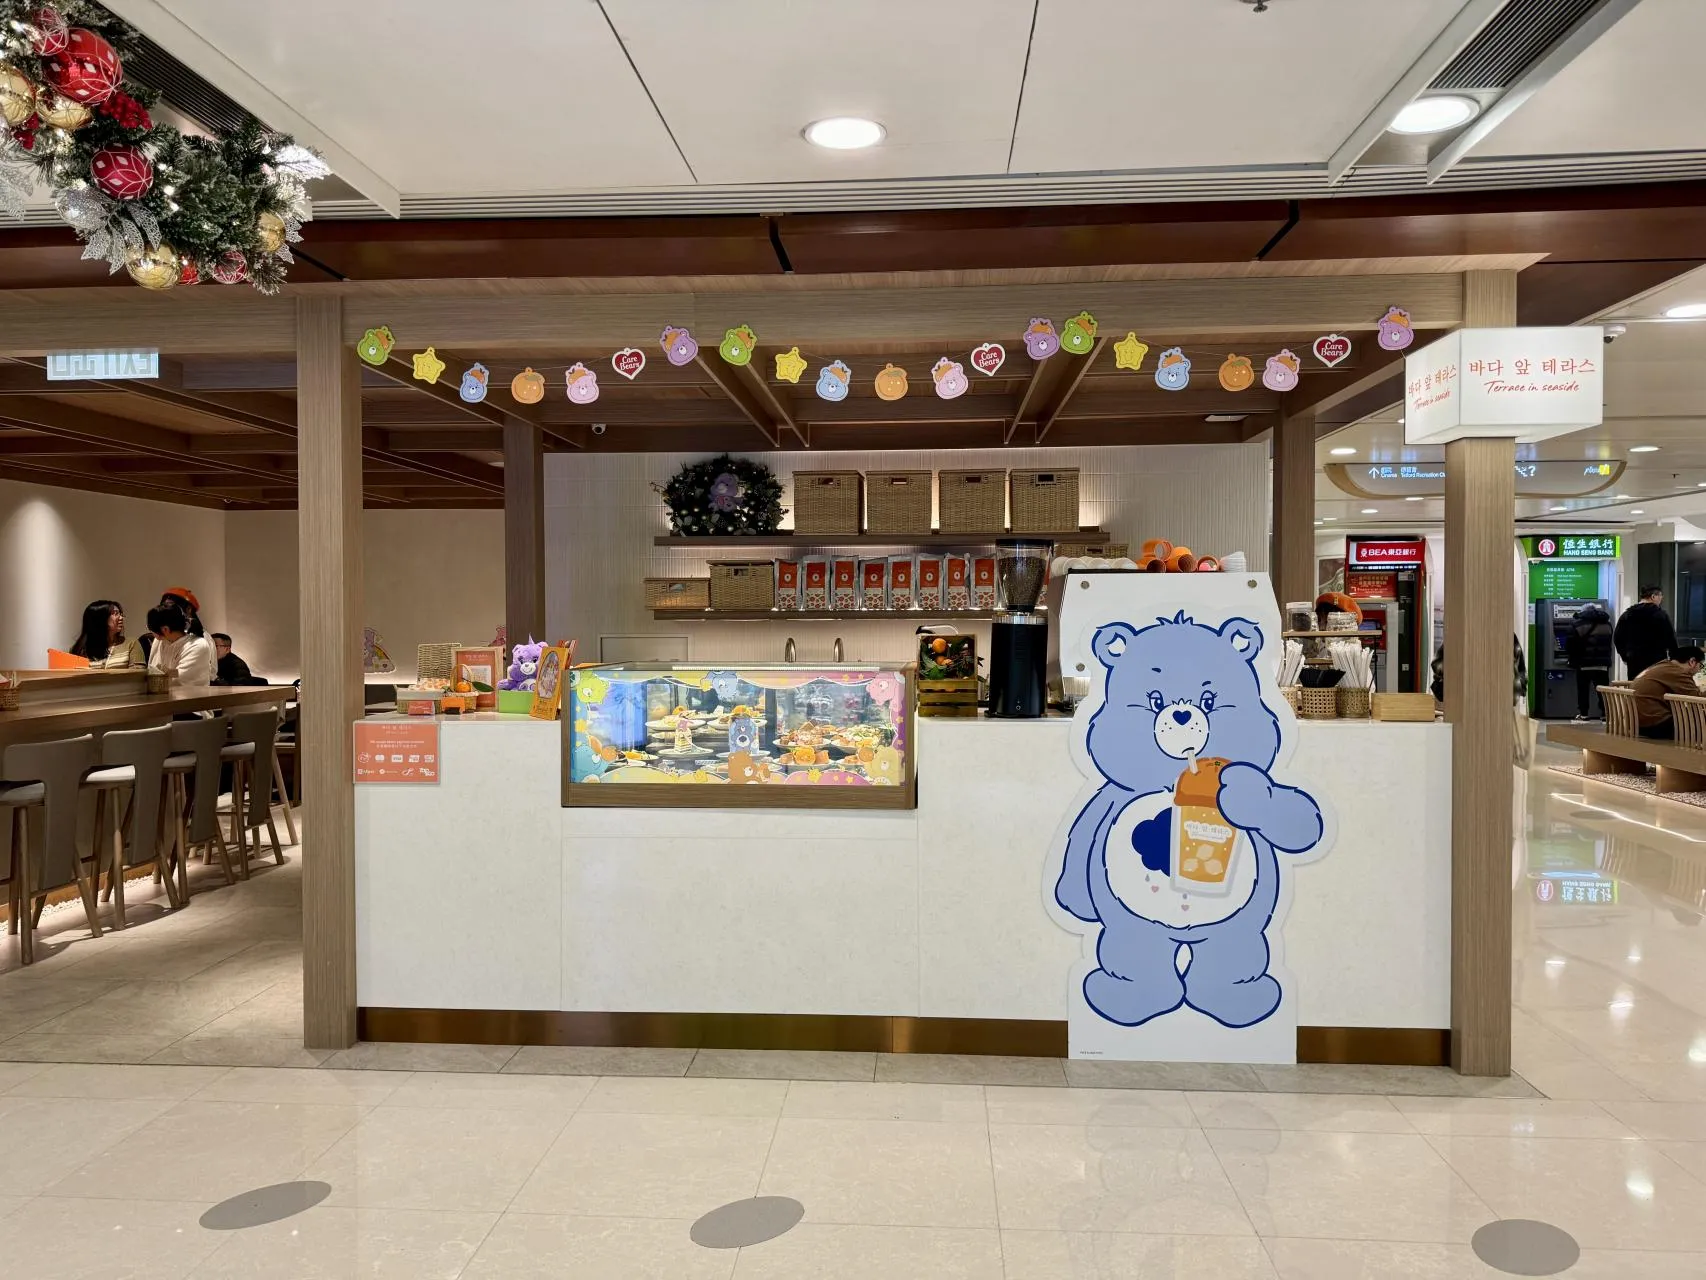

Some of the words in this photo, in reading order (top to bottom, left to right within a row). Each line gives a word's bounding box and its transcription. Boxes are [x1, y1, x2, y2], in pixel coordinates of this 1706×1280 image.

[1325, 342, 1343, 350] Care
[981, 351, 997, 360] Care
[1321, 348, 1344, 356] Bears
[620, 361, 640, 371] Bears
[979, 358, 1000, 368] Bears
[1469, 359, 1504, 376] 바다
[1515, 359, 1532, 375] 앞
[1542, 358, 1596, 375] 테라스
[1484, 380, 1526, 394] Terrace
[1528, 383, 1538, 391] in
[1542, 380, 1580, 392] seaside
